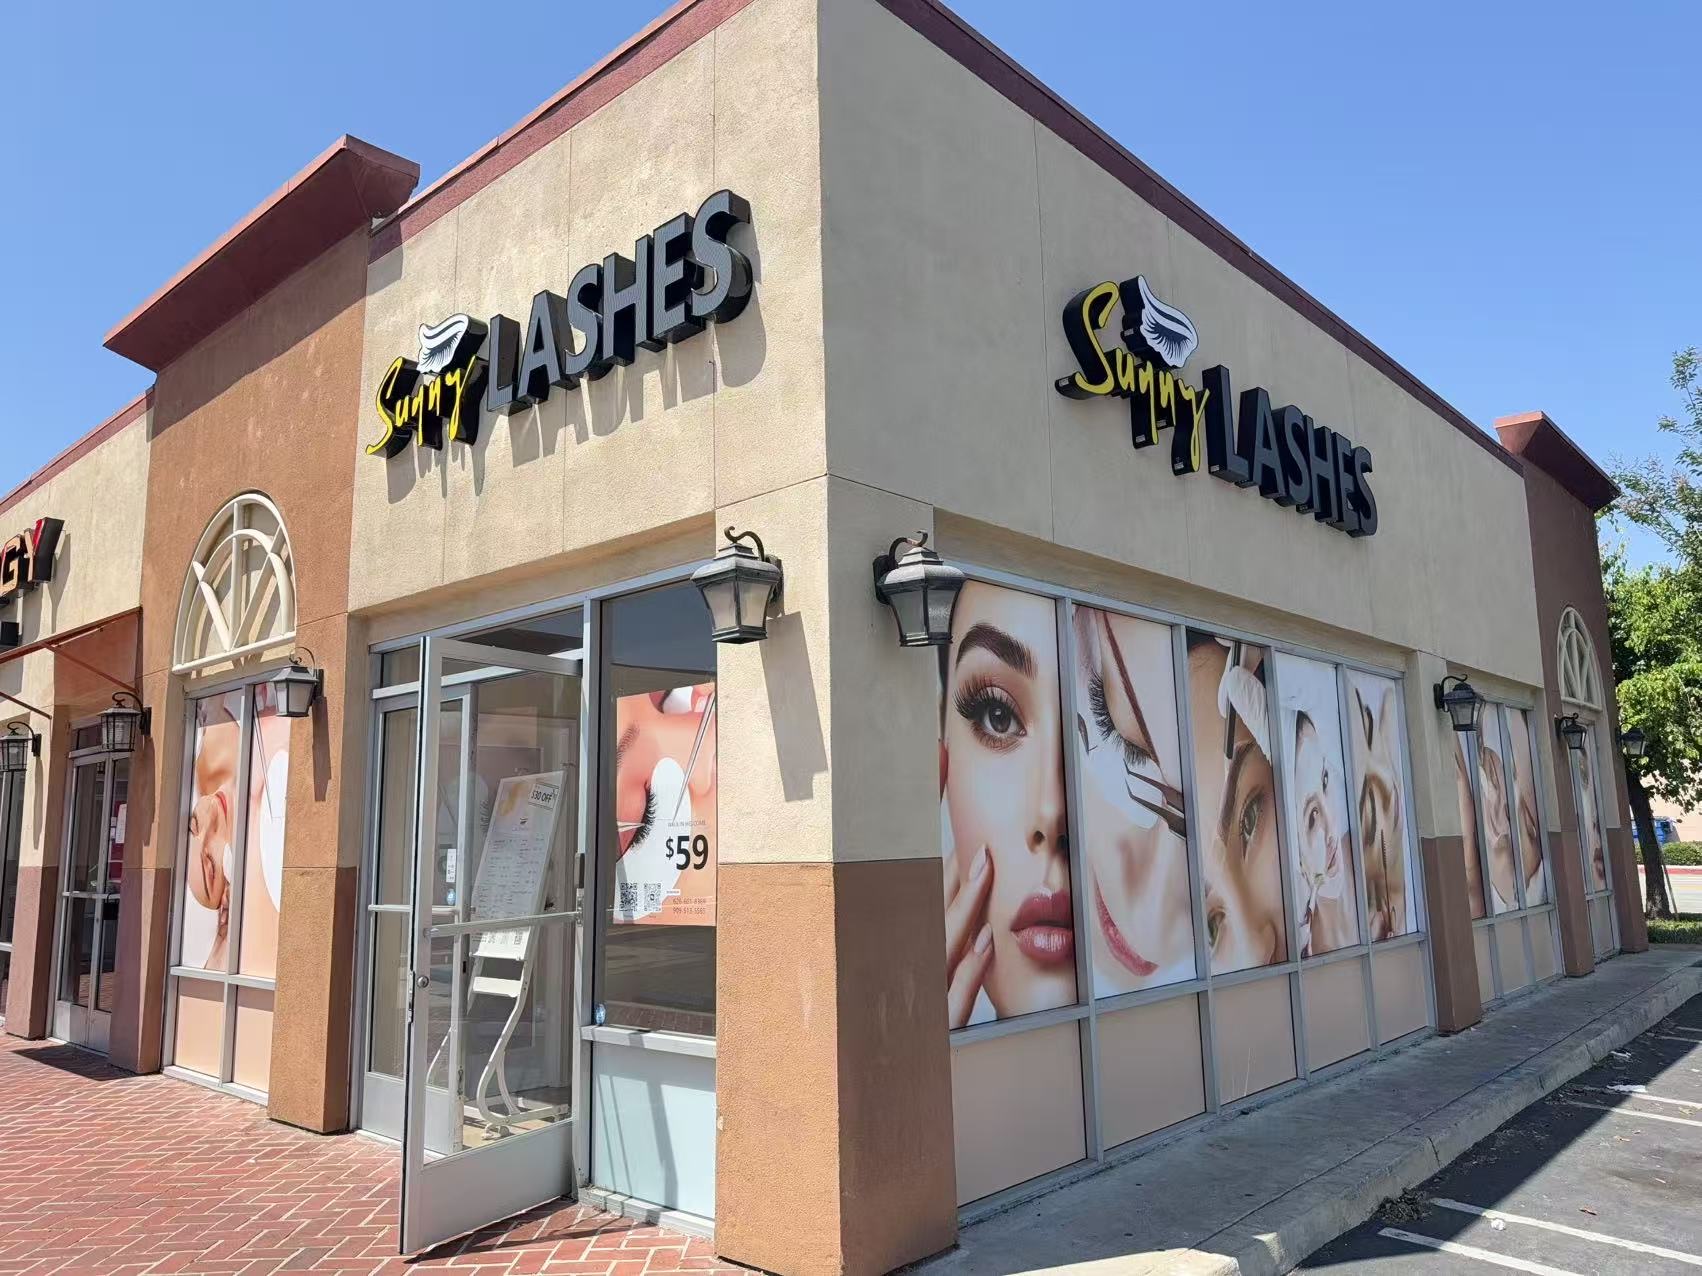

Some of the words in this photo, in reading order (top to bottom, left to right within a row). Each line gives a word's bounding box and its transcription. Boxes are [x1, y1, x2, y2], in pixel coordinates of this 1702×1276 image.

[366, 356, 478, 455] Sunny
[487, 189, 748, 414] LASHES
[1062, 280, 1210, 475] Sunny
[1207, 365, 1378, 539] LASHES
[665, 834, 709, 870] $59
